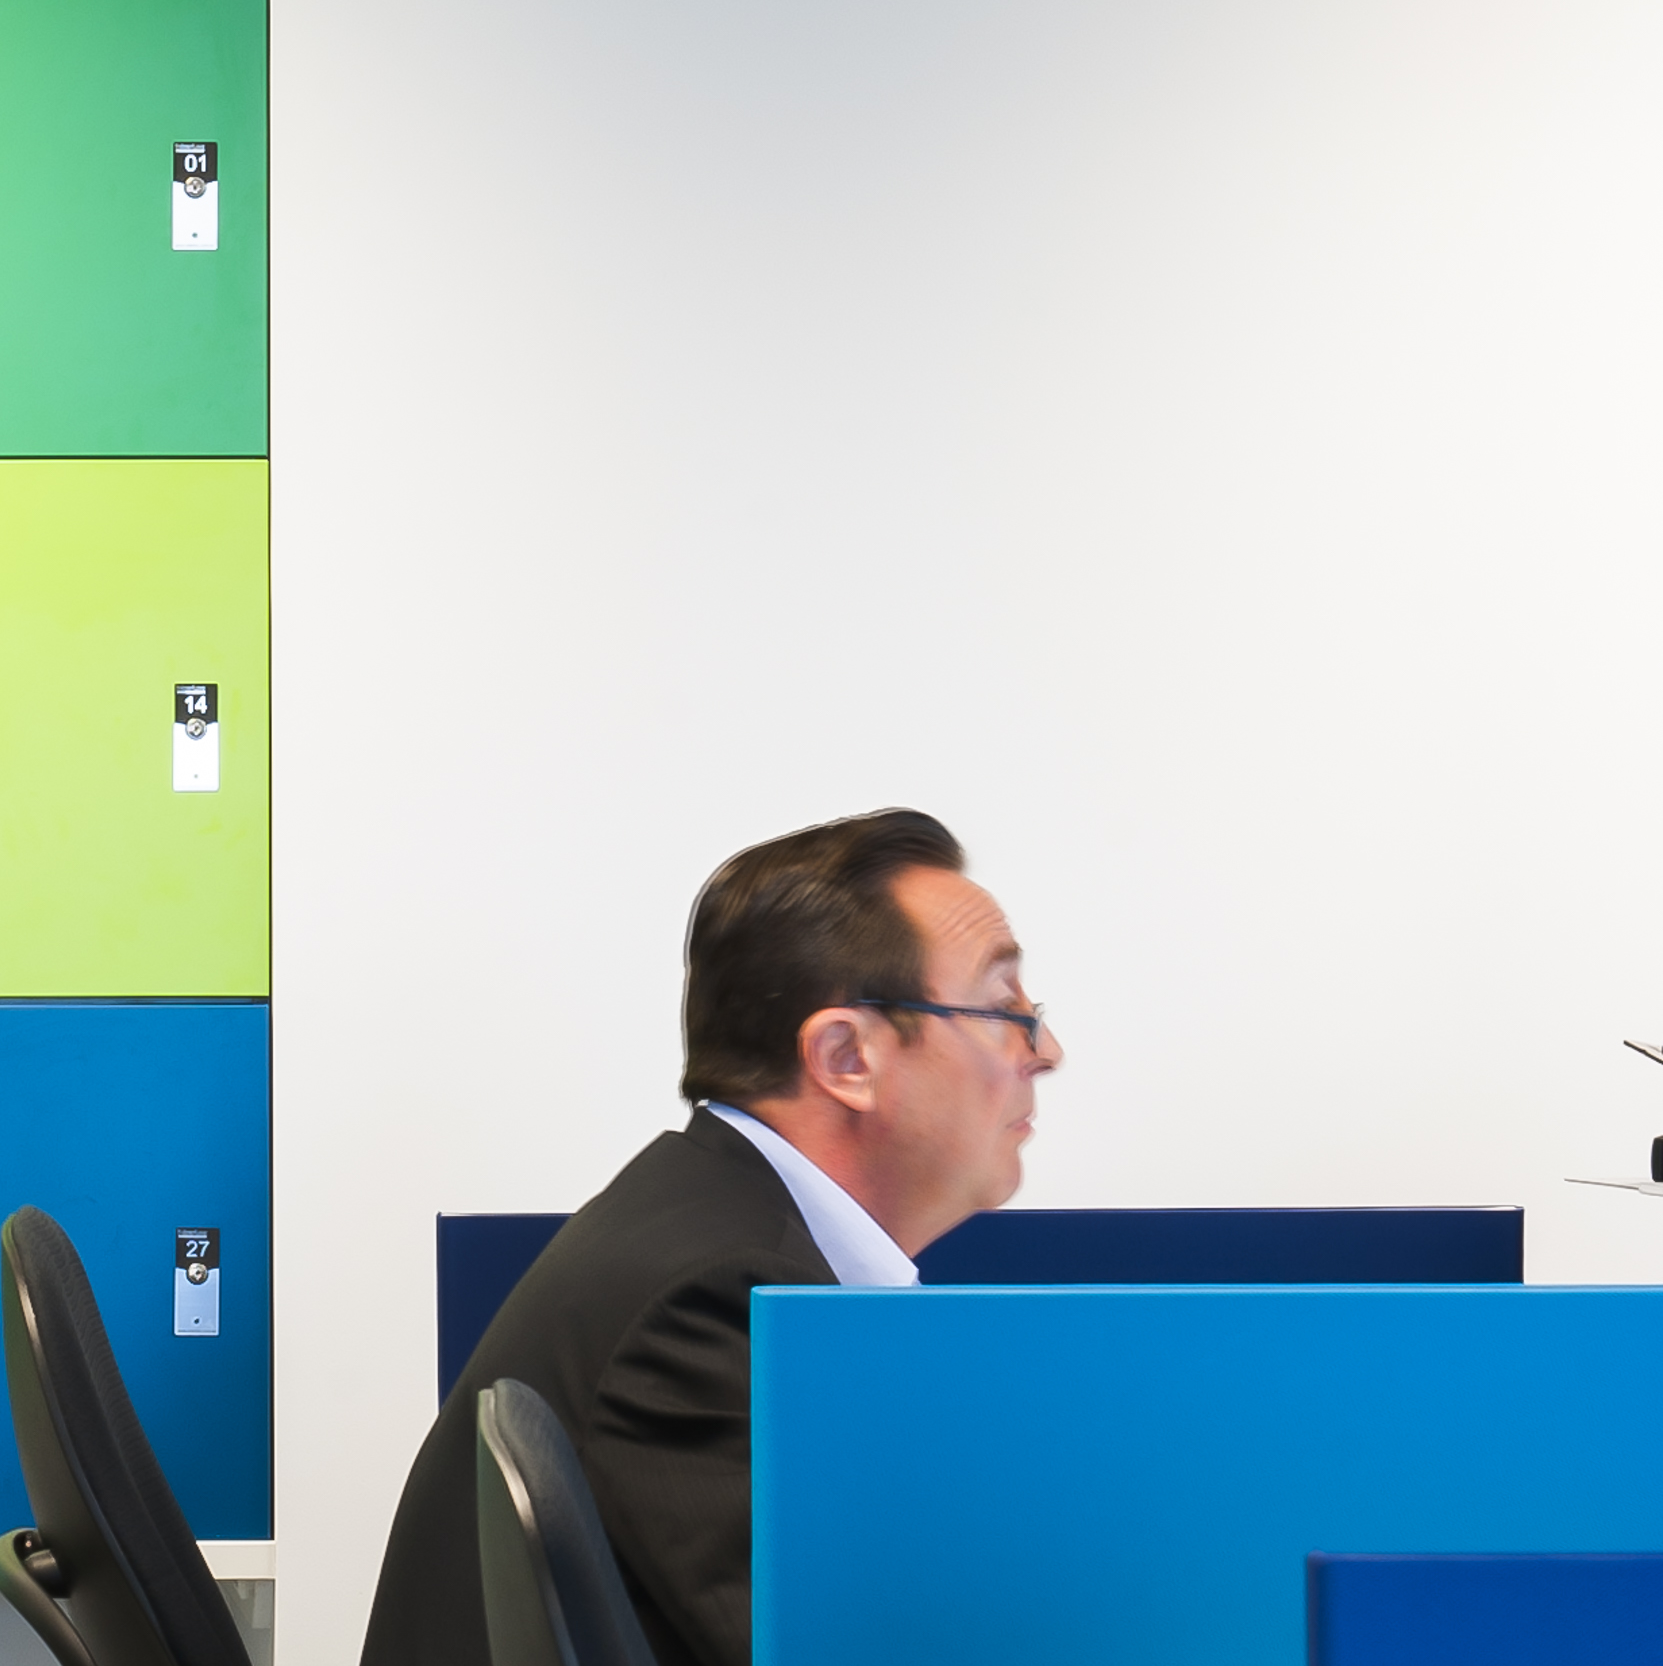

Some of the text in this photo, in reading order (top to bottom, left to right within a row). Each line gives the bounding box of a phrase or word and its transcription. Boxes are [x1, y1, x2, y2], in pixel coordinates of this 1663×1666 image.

[184, 154, 206, 173] 01
[184, 695, 207, 714] 14
[186, 1241, 210, 1257] 27
